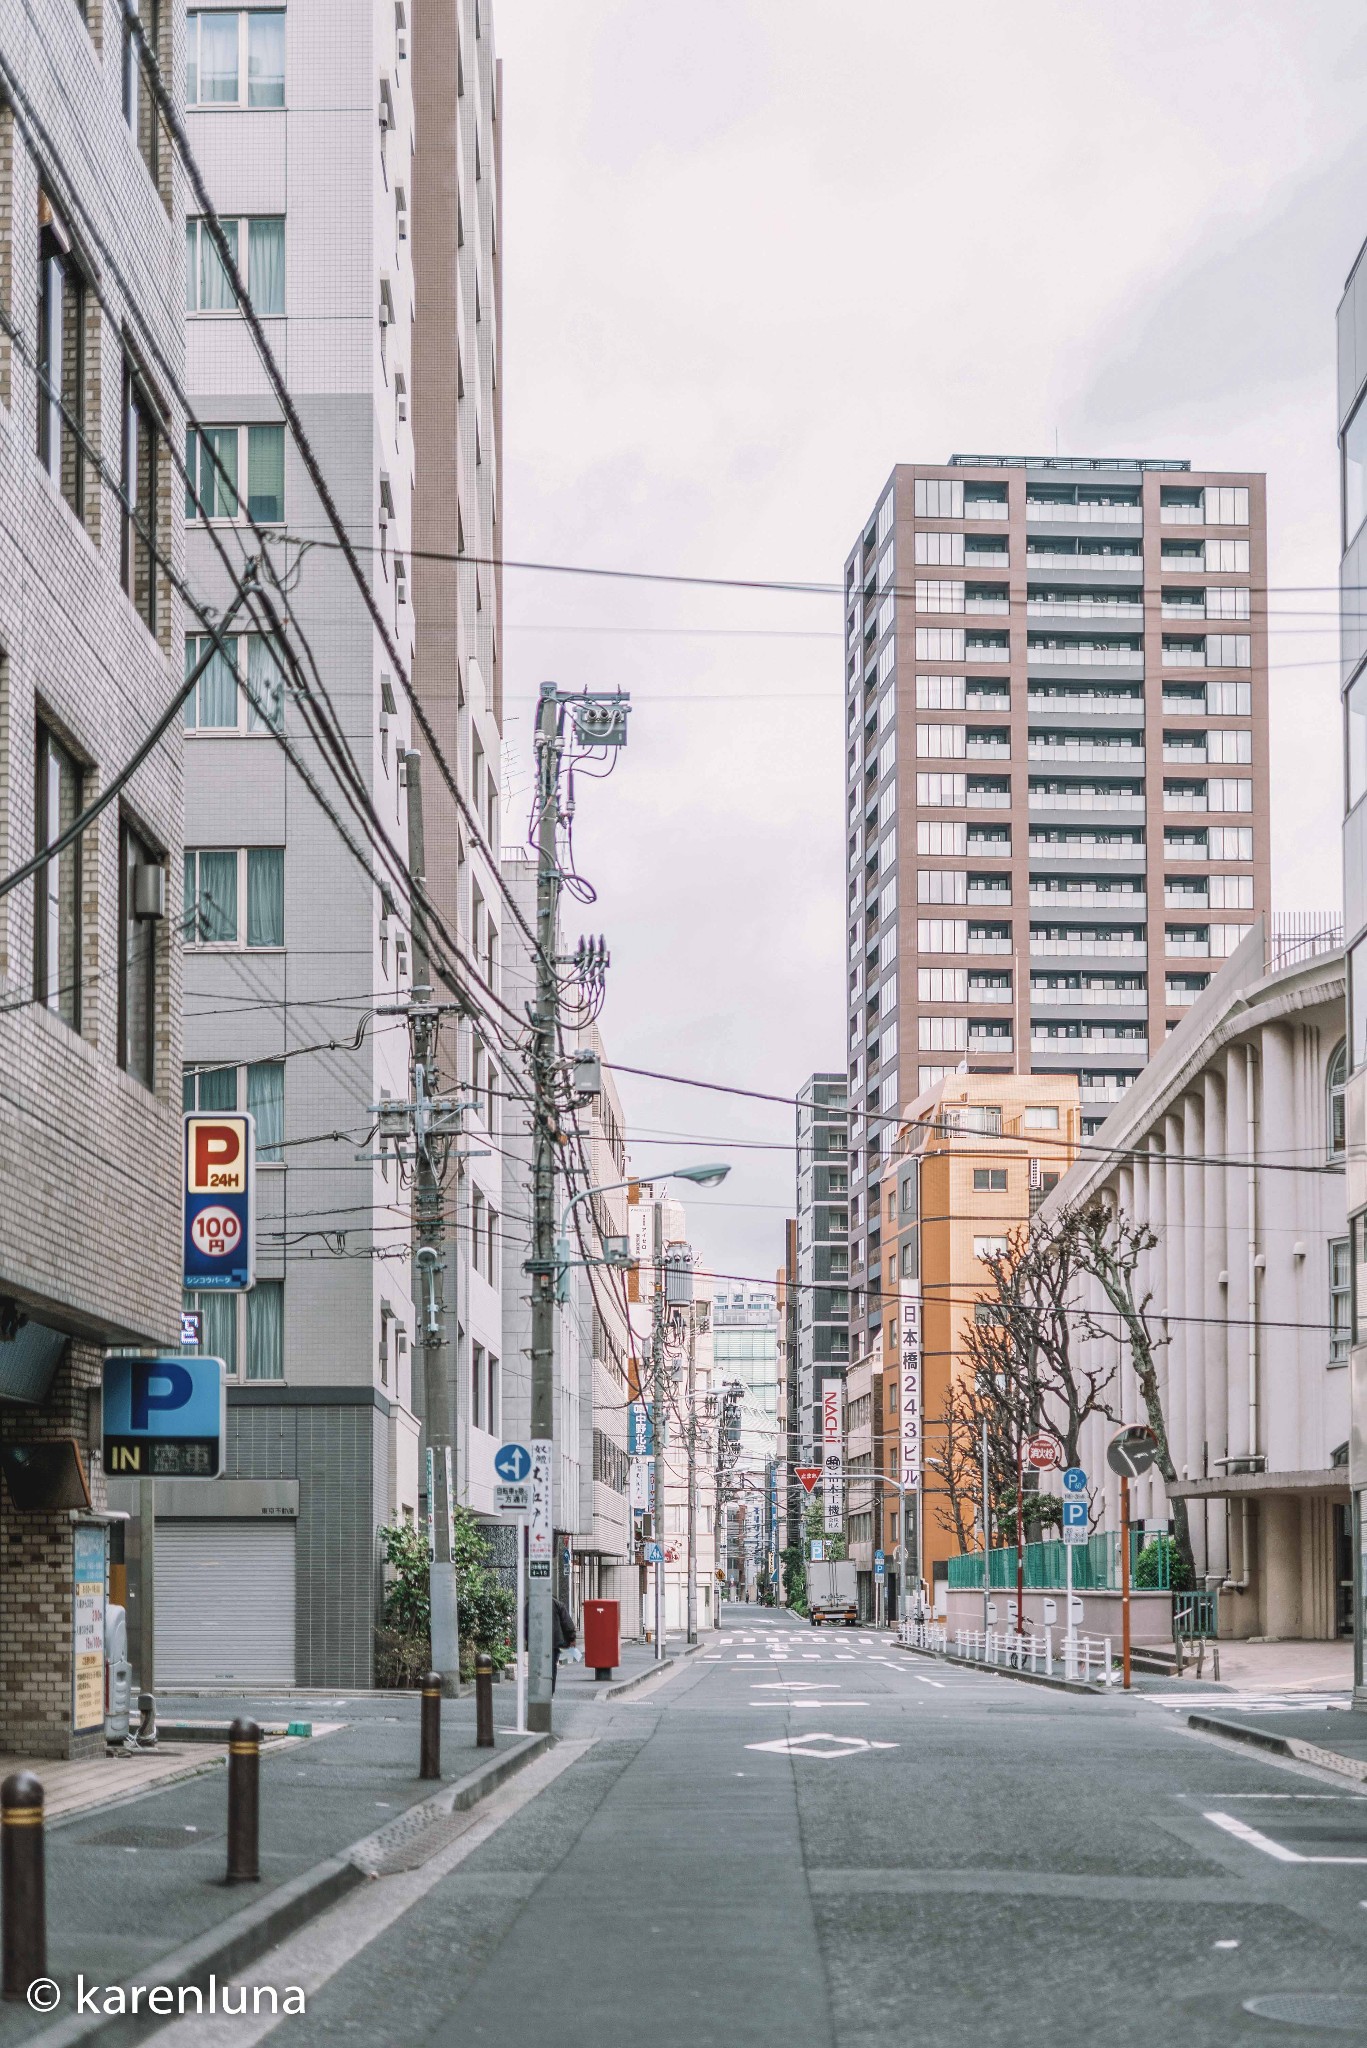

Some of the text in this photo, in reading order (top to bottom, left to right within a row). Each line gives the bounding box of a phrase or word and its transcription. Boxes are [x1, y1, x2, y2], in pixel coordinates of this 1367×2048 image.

[195, 1126, 239, 1187] P
[209, 1173, 239, 1187] 24H
[196, 1217, 237, 1238] 100
[208, 1239, 225, 1253] 円
[186, 1276, 231, 1285] シンコウパーク
[130, 1362, 193, 1430] P
[902, 1304, 919, 1485] 日本橋243ビル
[635, 1413, 647, 1455] 中野化学
[111, 1446, 140, 1471] IN
[1030, 1447, 1055, 1459] 消火栓
[801, 1472, 818, 1480] 止まれ
[1068, 1474, 1077, 1489] P
[496, 1495, 529, 1504] 一方通行
[1069, 1504, 1083, 1524] P
